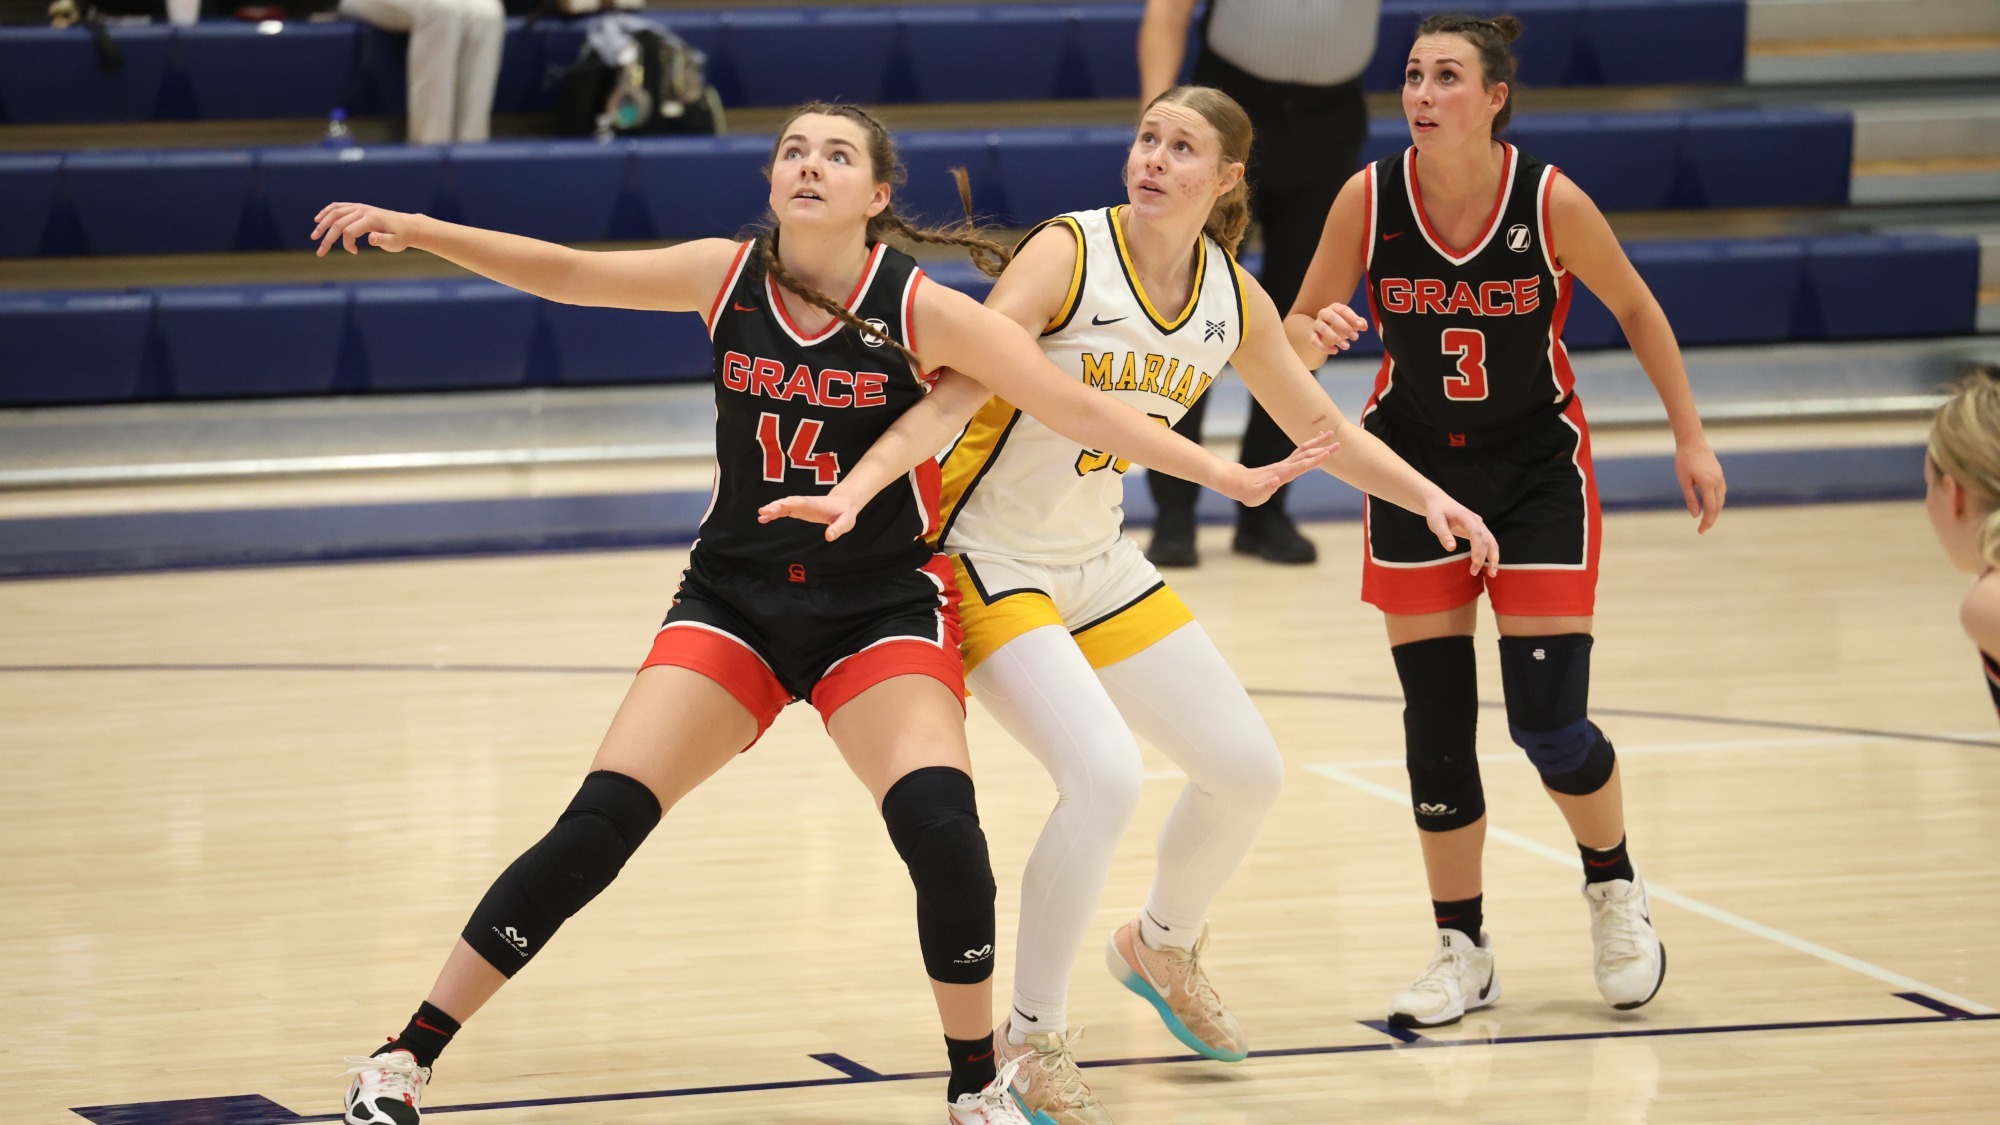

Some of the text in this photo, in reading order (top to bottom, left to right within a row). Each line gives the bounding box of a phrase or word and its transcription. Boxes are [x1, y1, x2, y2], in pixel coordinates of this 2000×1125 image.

[1381, 275, 1540, 316] GRACE
[723, 351, 888, 408] GRACE
[1441, 328, 1489, 401] 3
[756, 412, 841, 485] 14
